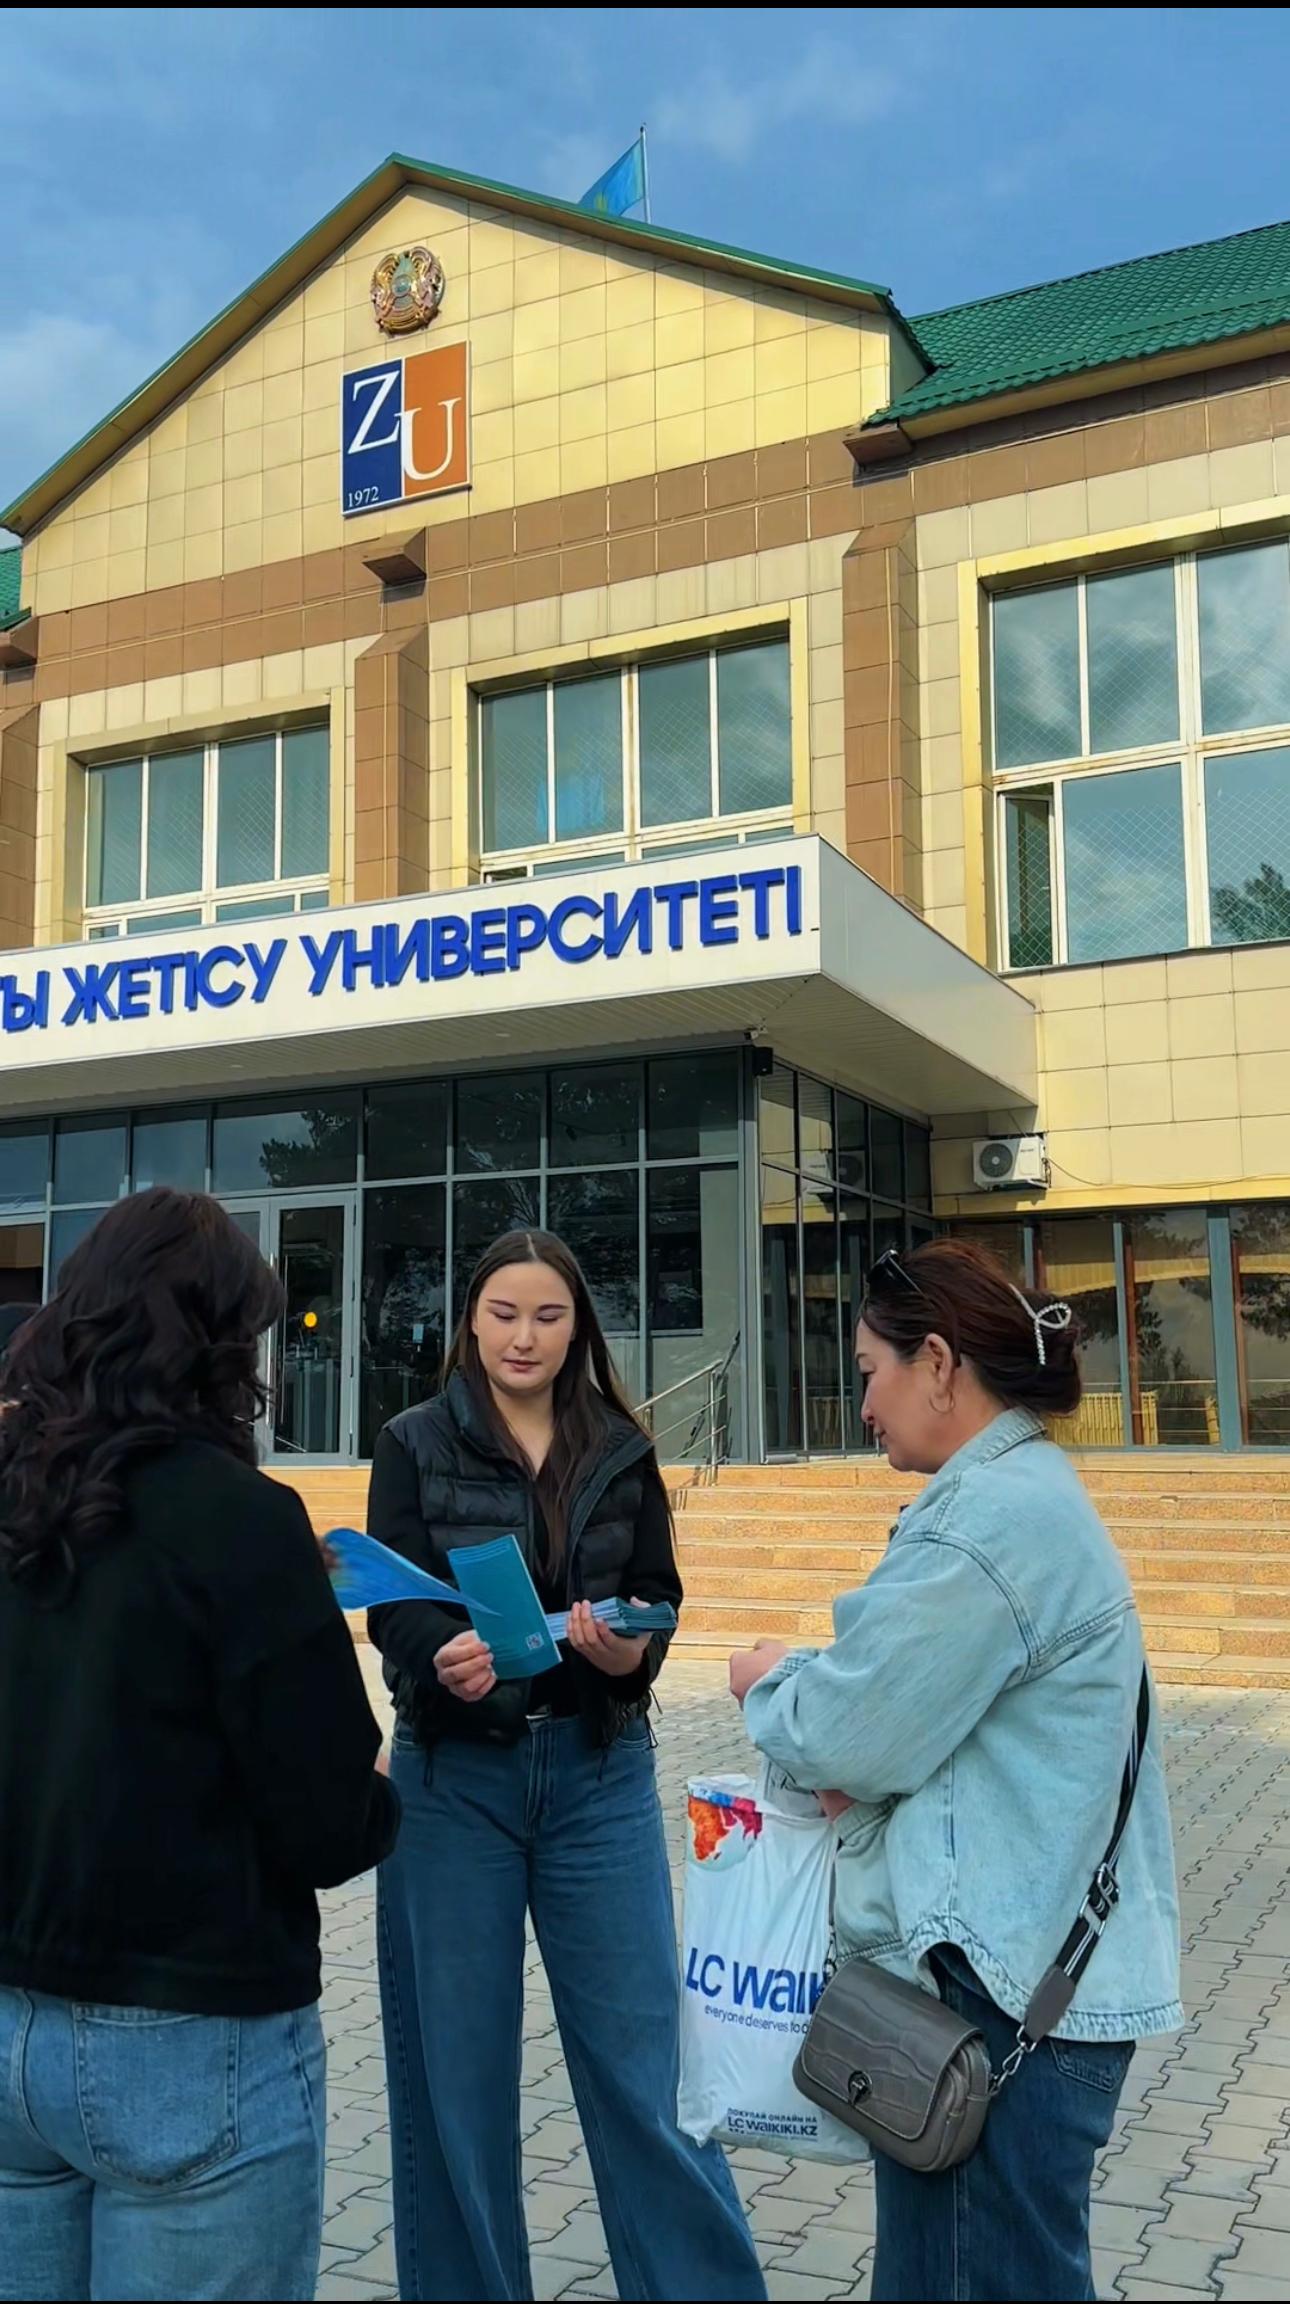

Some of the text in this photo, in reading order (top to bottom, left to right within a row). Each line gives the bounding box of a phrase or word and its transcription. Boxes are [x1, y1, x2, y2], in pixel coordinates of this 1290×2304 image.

[347, 486, 380, 508] 1972
[61, 937, 288, 1026] ЖЕТІСУ
[300, 865, 802, 996] УНИВЕРСИТЕТІ
[686, 1947, 725, 1998] LC
[704, 2004, 744, 2023] everyone
[745, 2013, 789, 2033] deserves
[728, 2116, 745, 2129] LC
